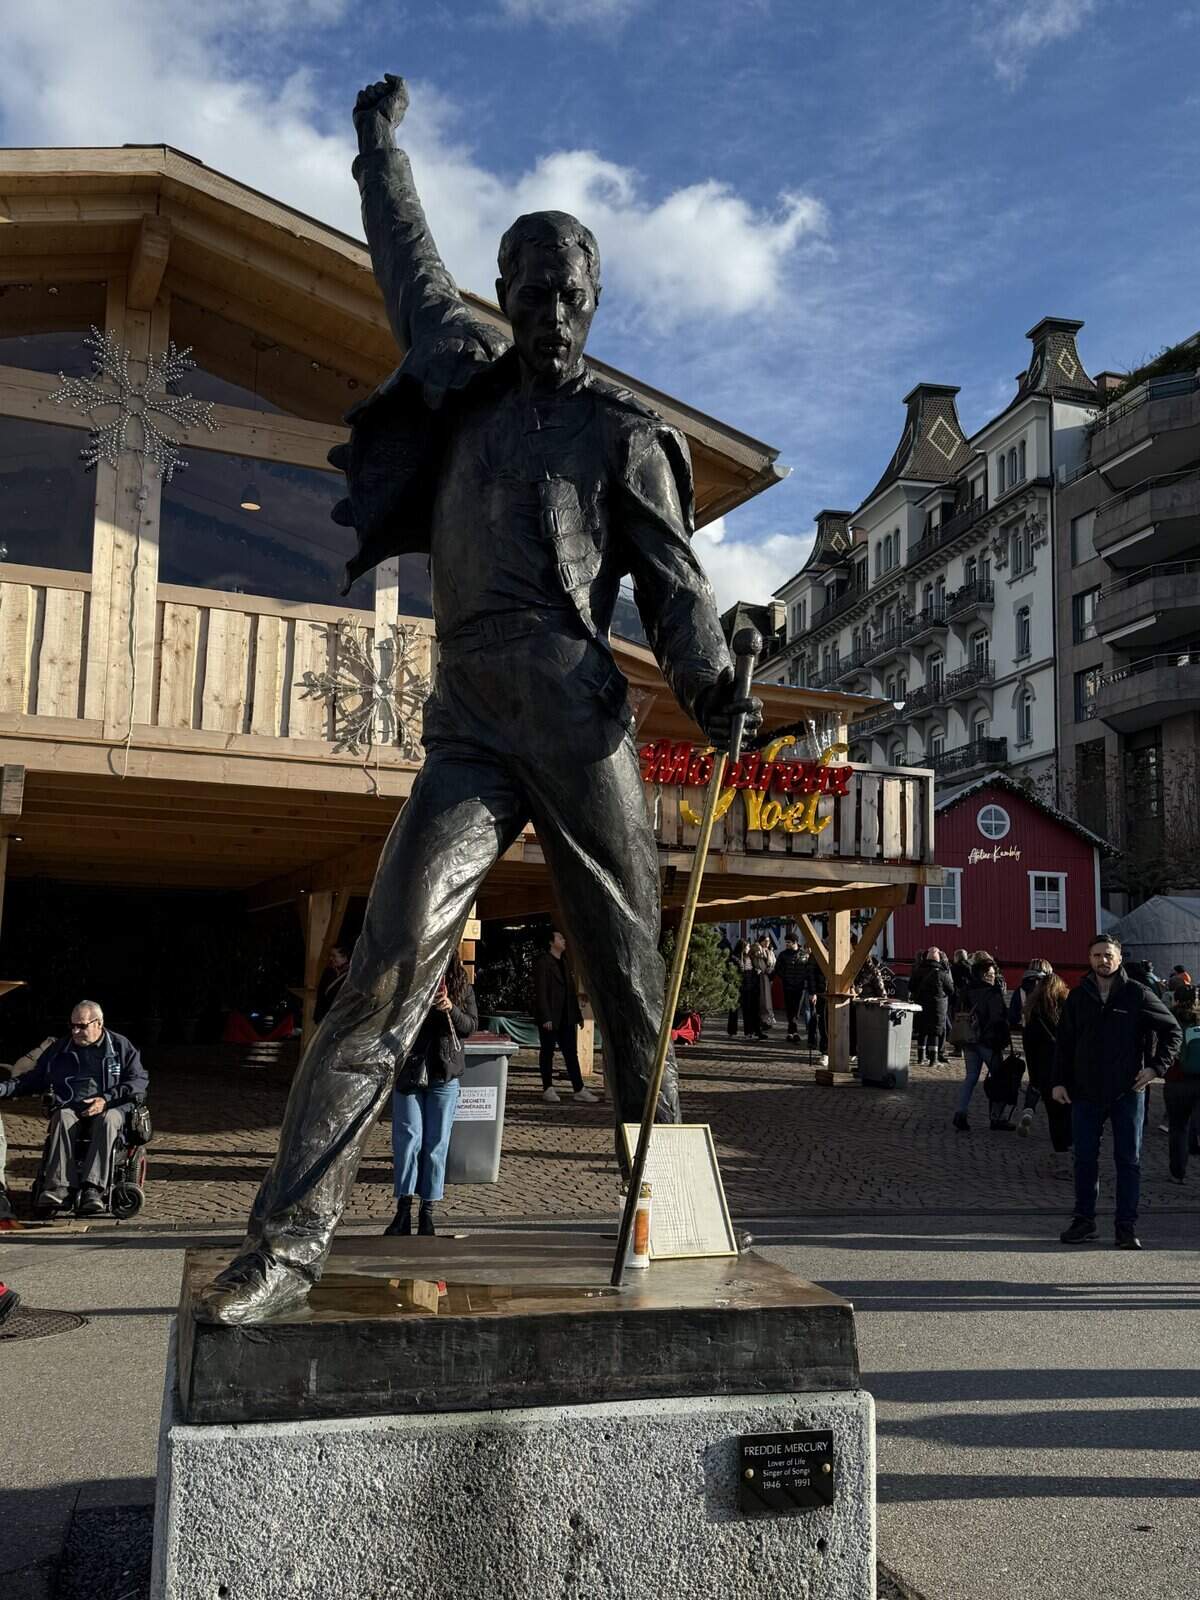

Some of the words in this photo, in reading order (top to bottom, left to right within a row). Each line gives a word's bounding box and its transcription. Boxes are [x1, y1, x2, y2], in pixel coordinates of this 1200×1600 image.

[744, 1444, 782, 1456] FREDDIE
[784, 1441, 828, 1453] MERCURY
[768, 1459, 785, 1468] Lover
[787, 1458, 793, 1466] of
[795, 1457, 806, 1465] Life
[763, 1469, 783, 1478] Singer
[792, 1467, 811, 1476] Songs
[763, 1480, 781, 1489] 1946
[794, 1478, 811, 1487] 1991
